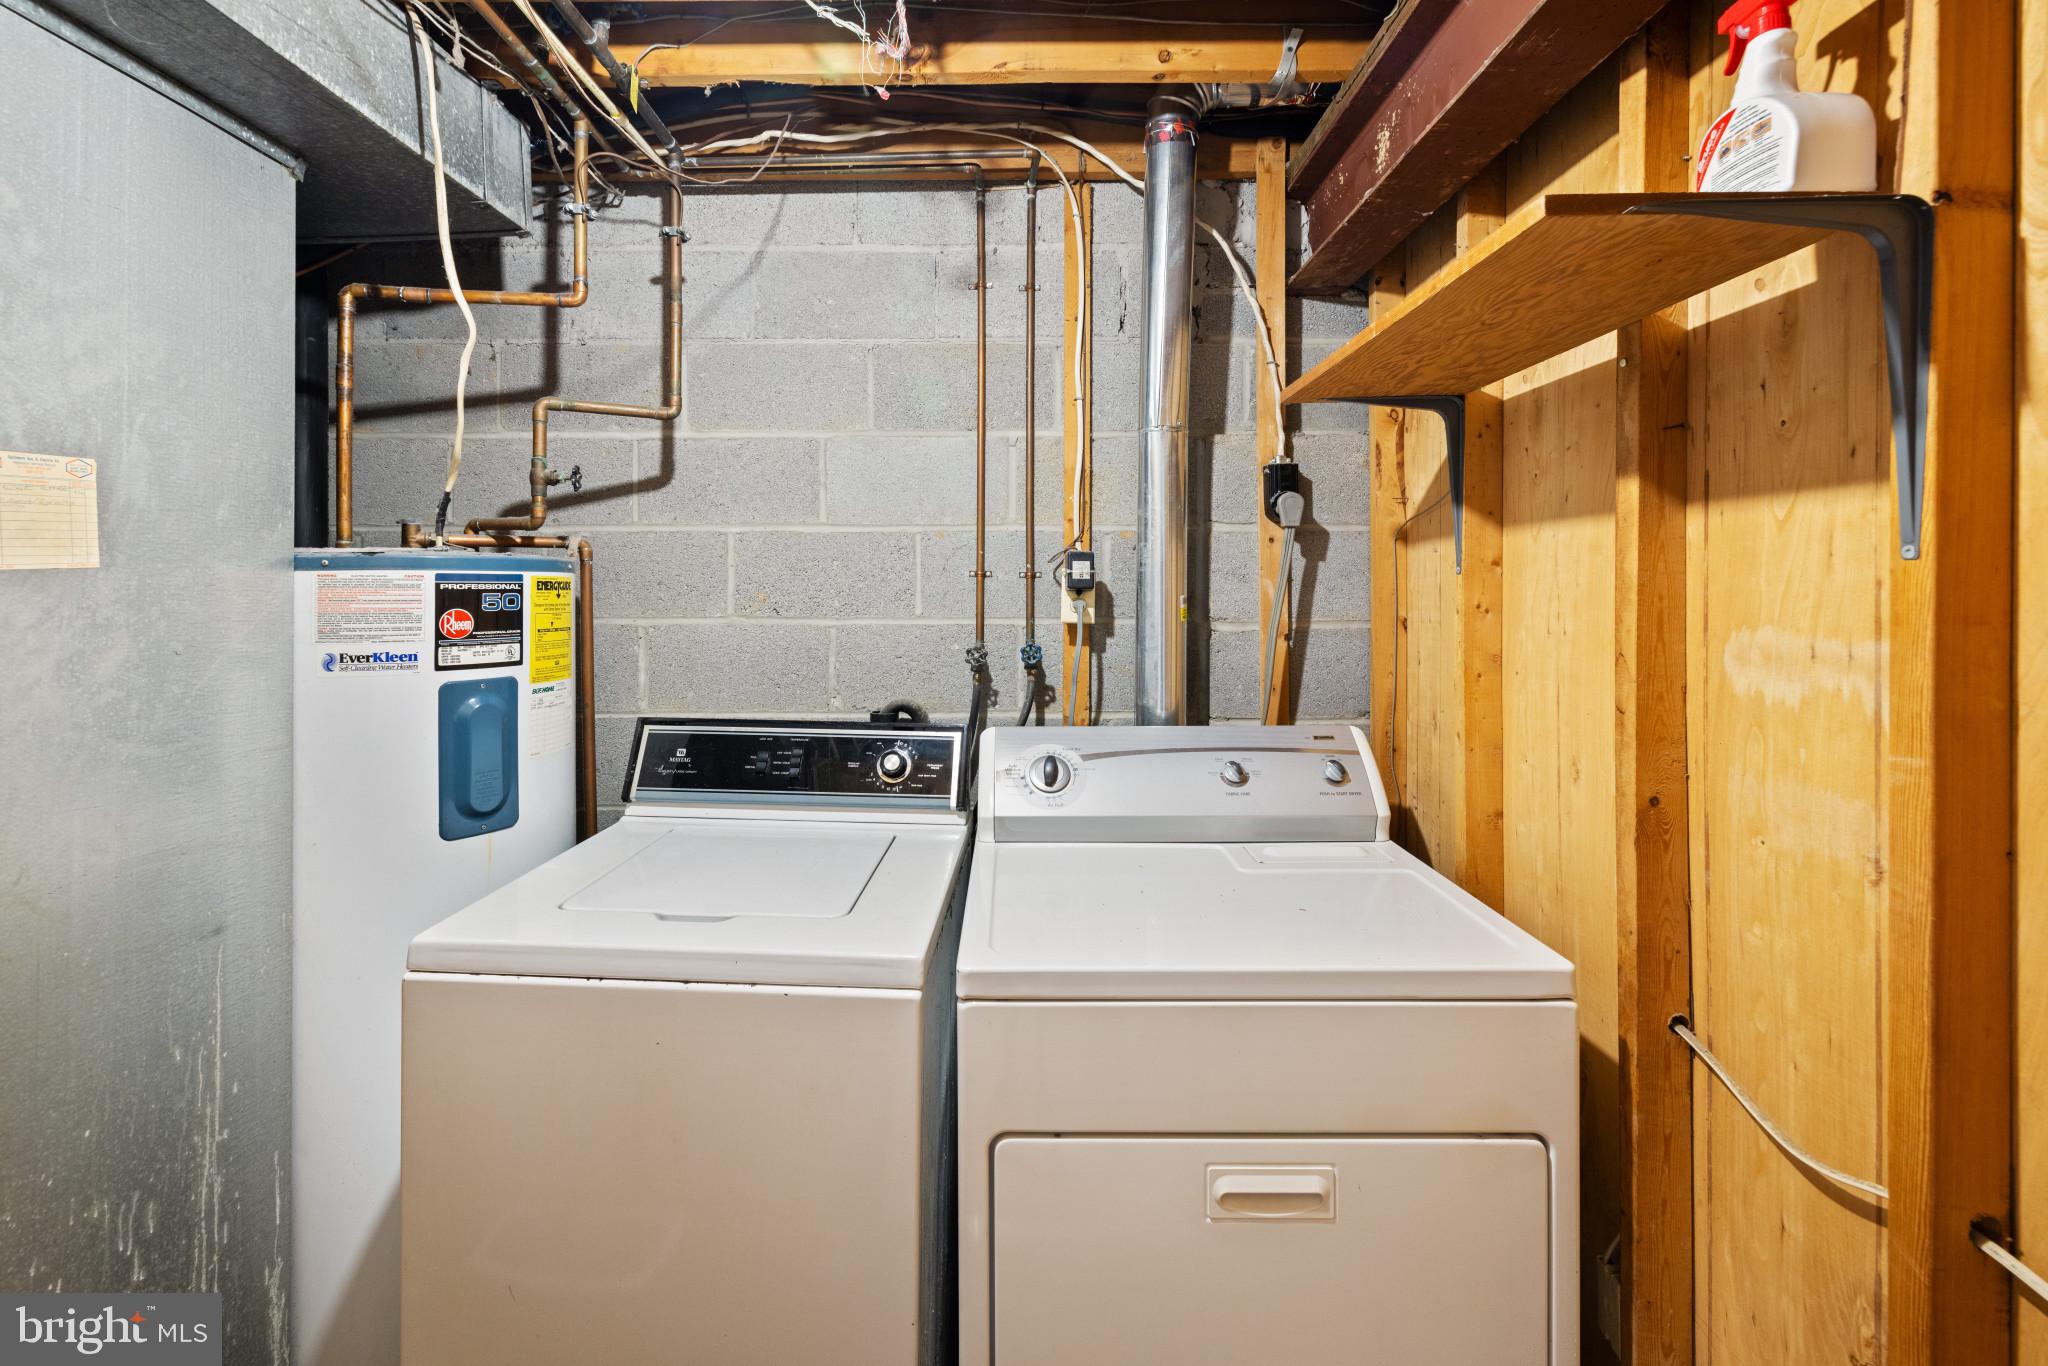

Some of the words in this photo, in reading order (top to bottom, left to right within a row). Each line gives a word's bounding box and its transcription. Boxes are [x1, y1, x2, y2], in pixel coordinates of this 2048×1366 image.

[481, 592, 521, 612] 50
[444, 610, 472, 635] Rheem
[339, 652, 418, 664] EverKleen
